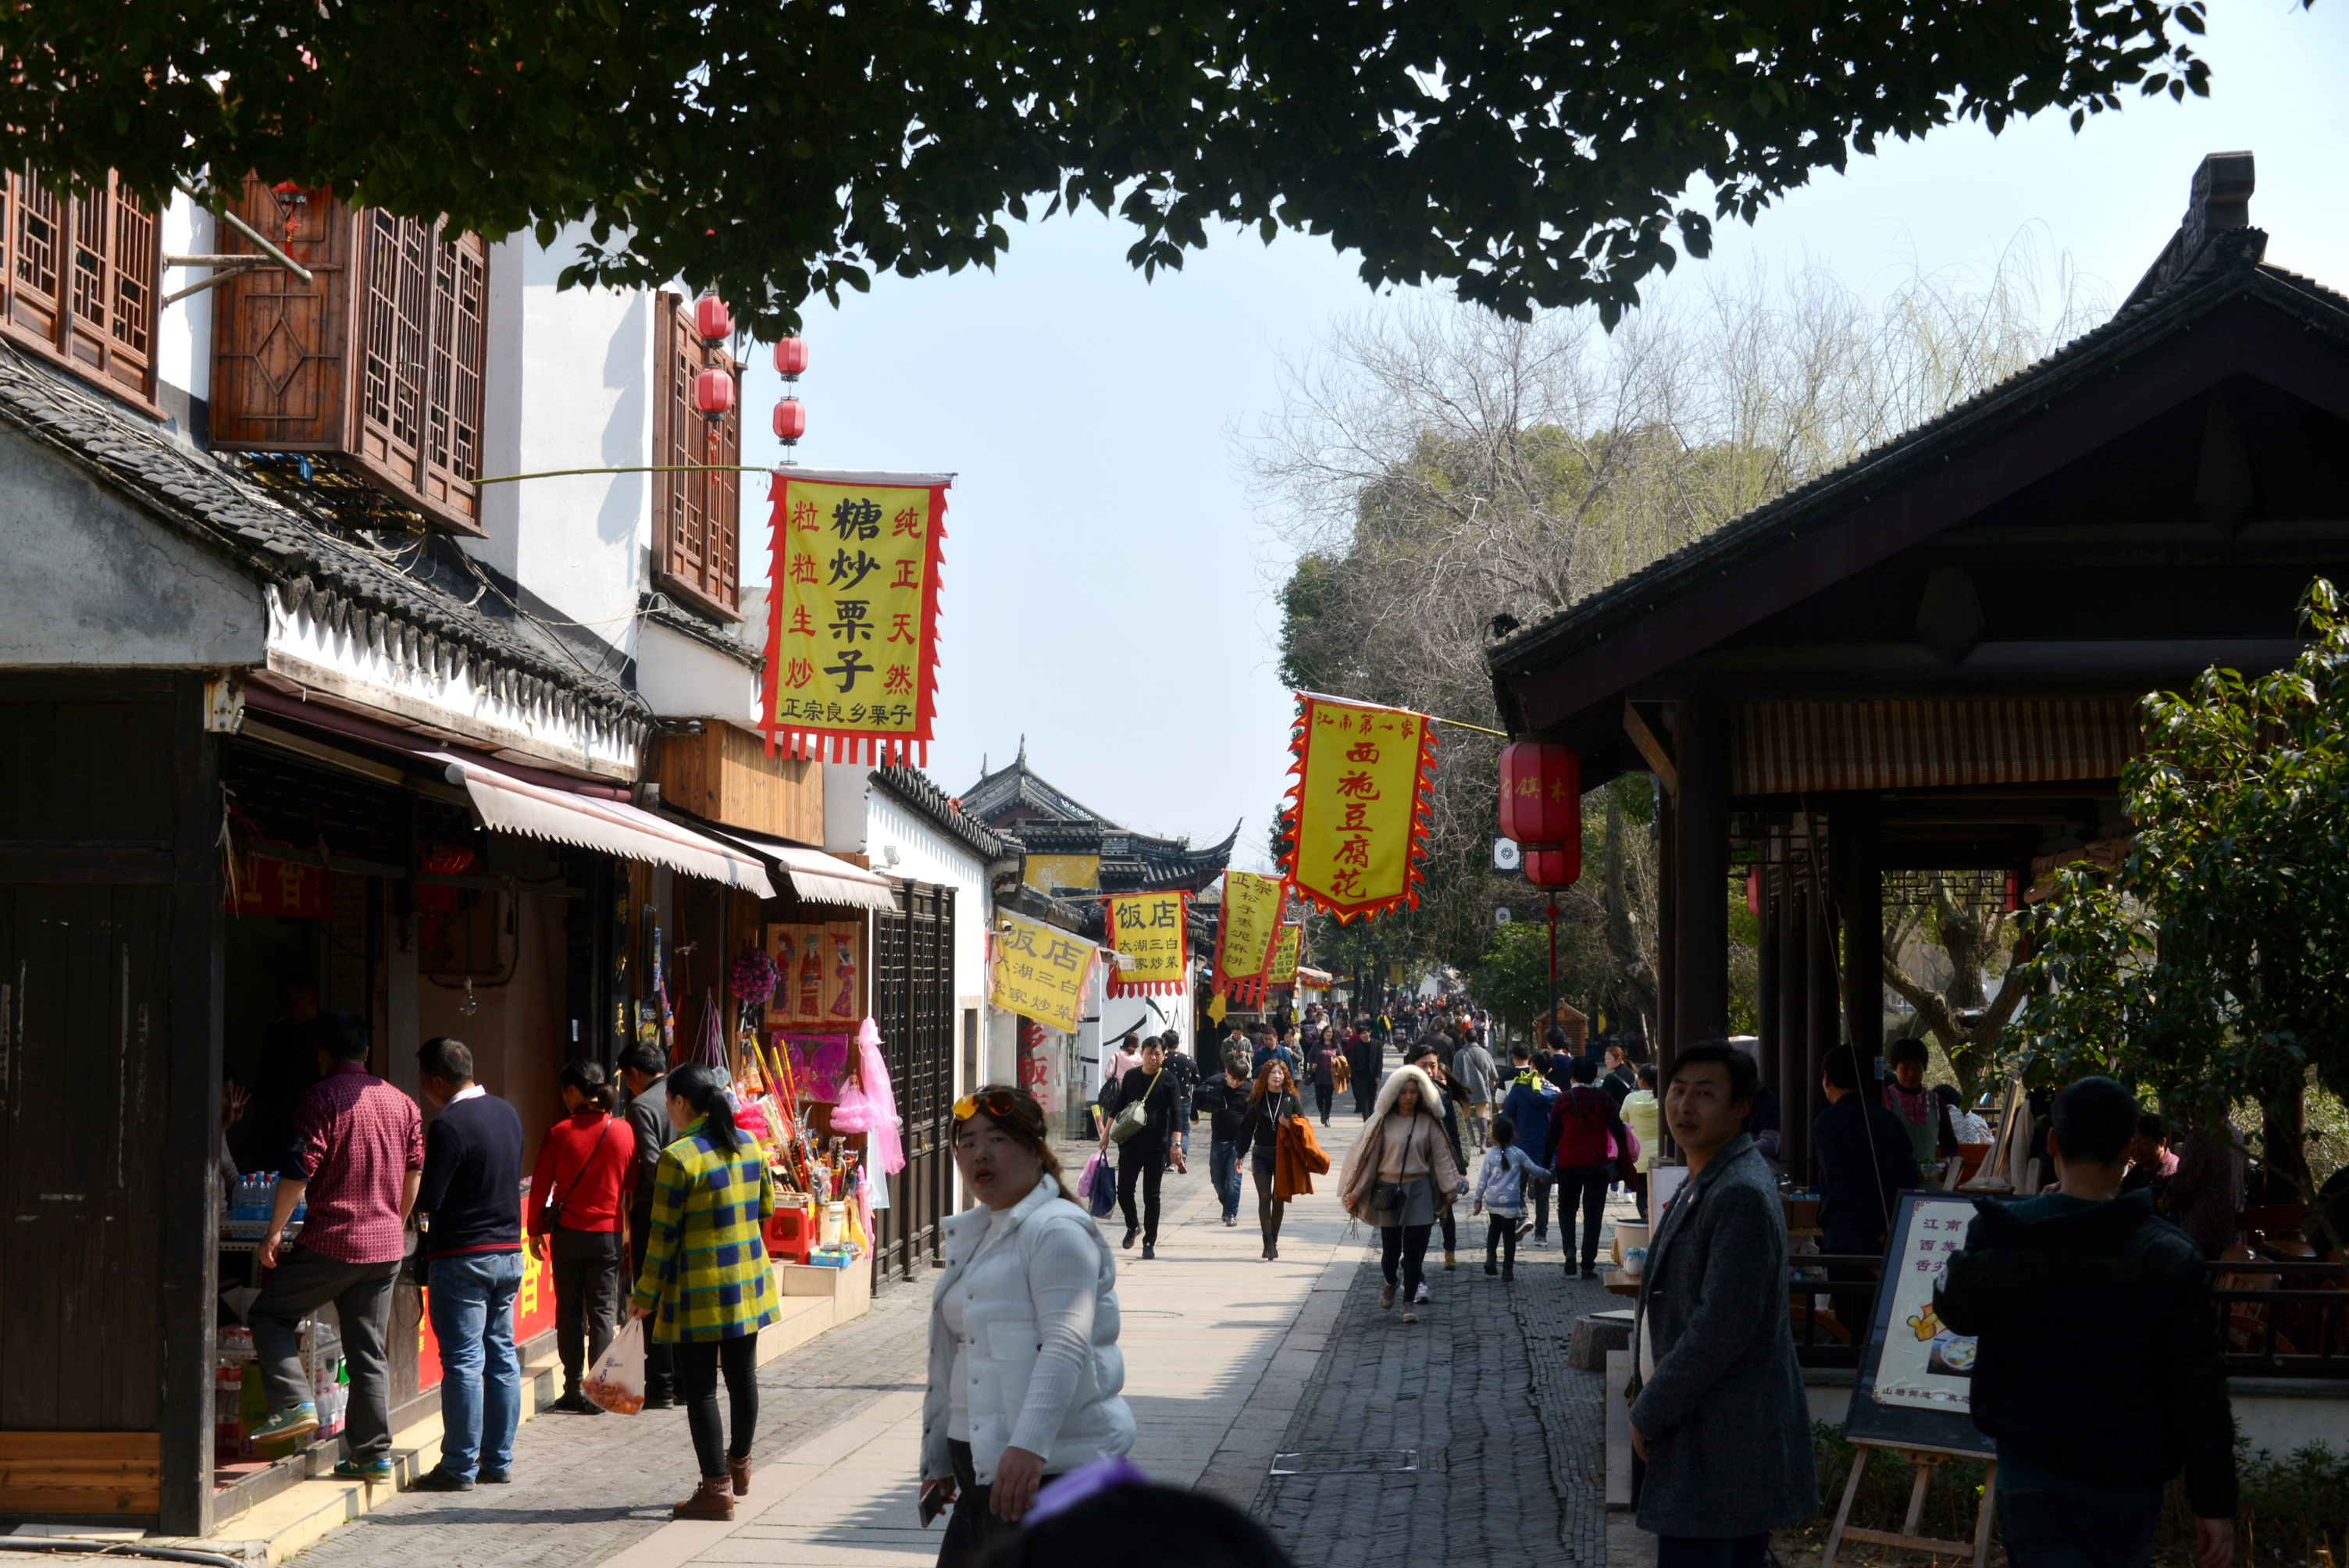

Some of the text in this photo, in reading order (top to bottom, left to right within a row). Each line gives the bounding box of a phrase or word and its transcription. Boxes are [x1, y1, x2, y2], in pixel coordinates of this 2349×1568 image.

[784, 500, 820, 690] 粒粒生炒
[823, 497, 882, 693] 糖炒栗子
[883, 506, 922, 696] 纯正天然
[781, 698, 912, 725] 正宗良乡栗子
[1317, 710, 1414, 740] 江南第一家
[1330, 742, 1380, 898] 西施豆腐花
[1232, 871, 1272, 896] 正宗
[1115, 900, 1178, 929] 饭店
[1226, 892, 1260, 967] 松子枣泥麻饼
[1003, 923, 1085, 972] 饭店
[1118, 937, 1178, 952] 太湖三白
[1000, 956, 1079, 996] 太湖三白
[1135, 956, 1179, 970] 家炒菜
[993, 979, 1074, 1021] 农家炒菜
[1923, 1219, 1962, 1231] 江南
[1919, 1239, 1956, 1252] 西施
